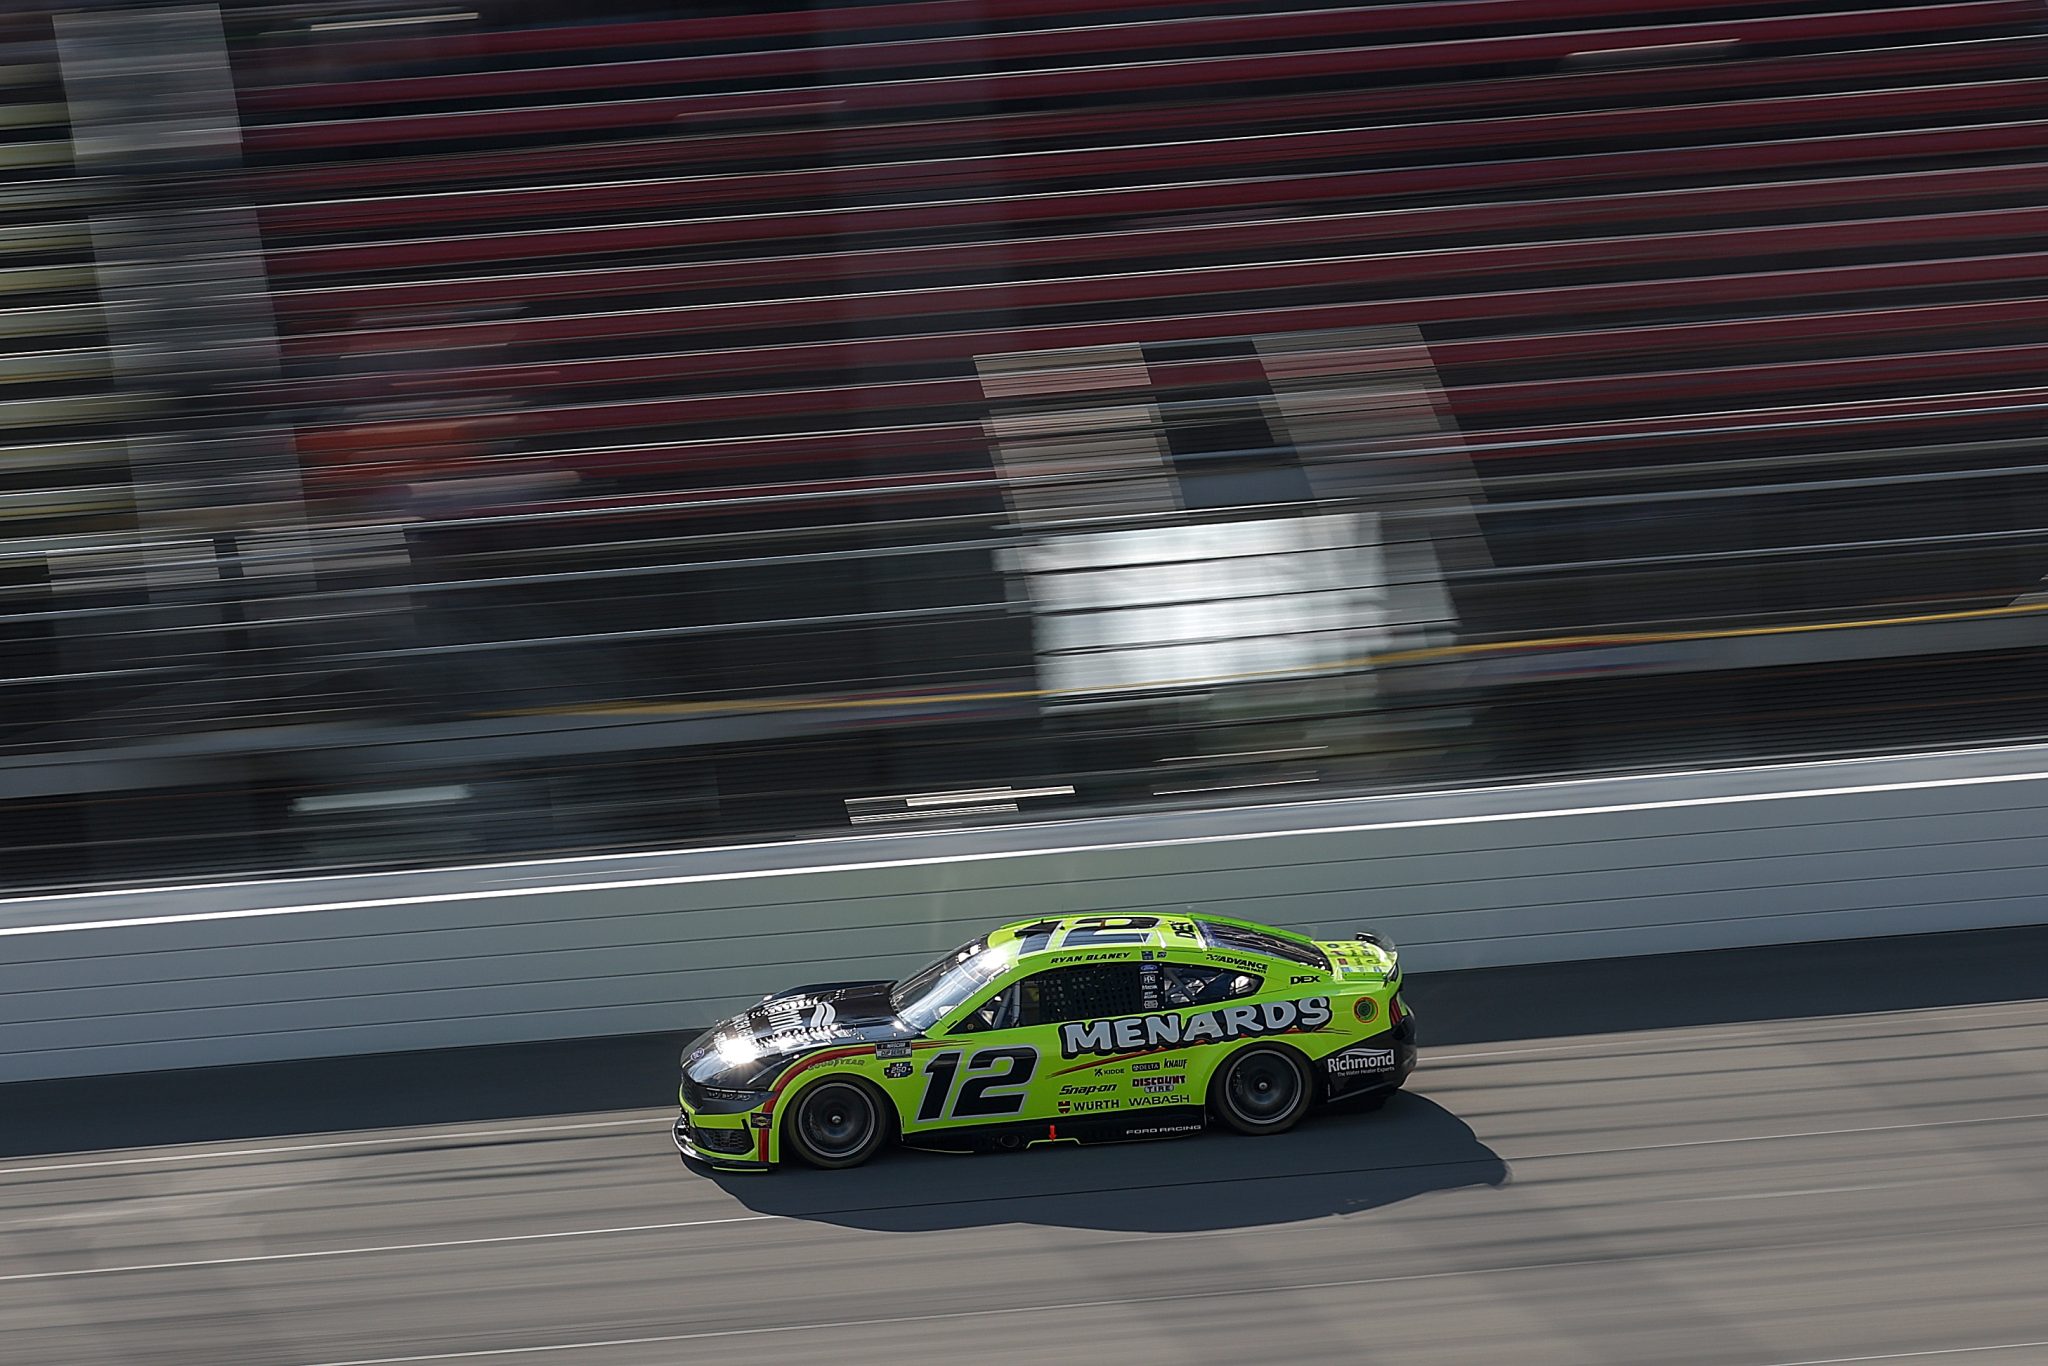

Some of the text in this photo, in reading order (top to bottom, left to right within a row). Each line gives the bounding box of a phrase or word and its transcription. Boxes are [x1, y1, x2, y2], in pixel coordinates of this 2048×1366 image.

[1051, 956, 1082, 964] RYAN
[1085, 952, 1131, 961] BLANEY
[1218, 955, 1268, 970] ADVANCE
[1290, 975, 1320, 985] DEX
[1061, 996, 1332, 1055] MENARDS
[1327, 1049, 1395, 1073] Richmond
[914, 1045, 1040, 1122] 12
[1132, 1075, 1186, 1088] DISCOUNT
[1059, 1083, 1118, 1096] Snap-on
[1147, 1085, 1172, 1093] TIRE
[1073, 1099, 1120, 1112] WÜRTH
[1128, 1094, 1190, 1107] WABASH
[1159, 1124, 1202, 1133] RACING
